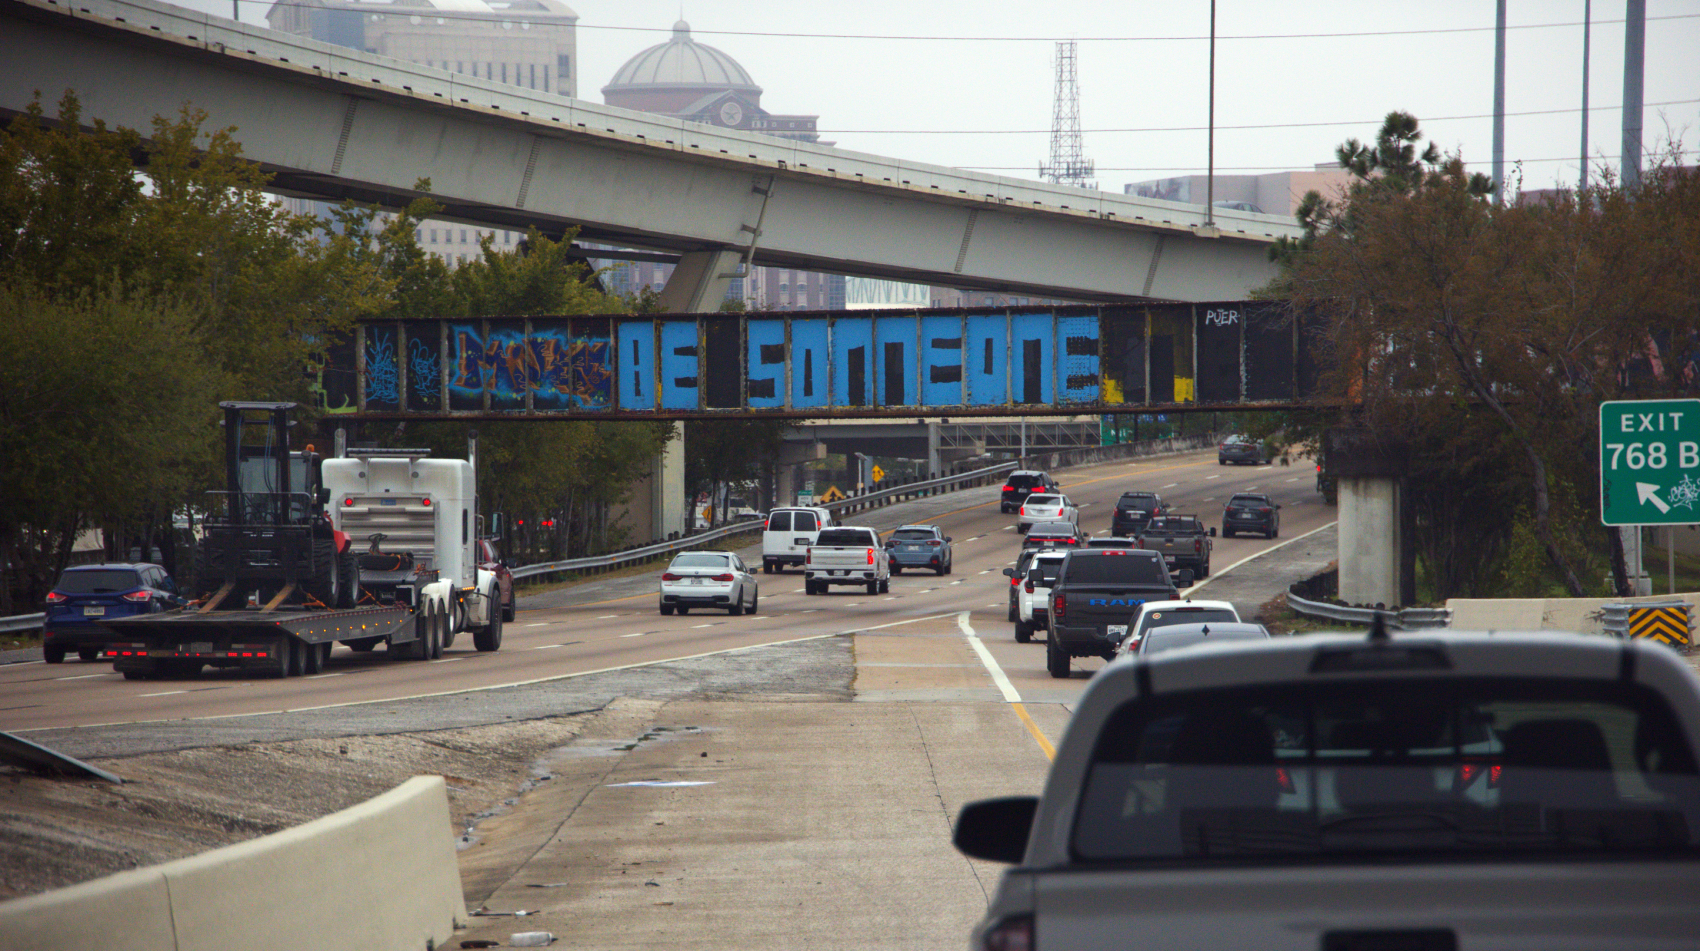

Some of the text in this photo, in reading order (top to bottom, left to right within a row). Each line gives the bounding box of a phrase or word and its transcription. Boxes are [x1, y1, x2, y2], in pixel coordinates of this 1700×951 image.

[1620, 412, 1684, 432] EXIT
[1606, 441, 1699, 470] 768 B
[1090, 598, 1146, 606] RAM
